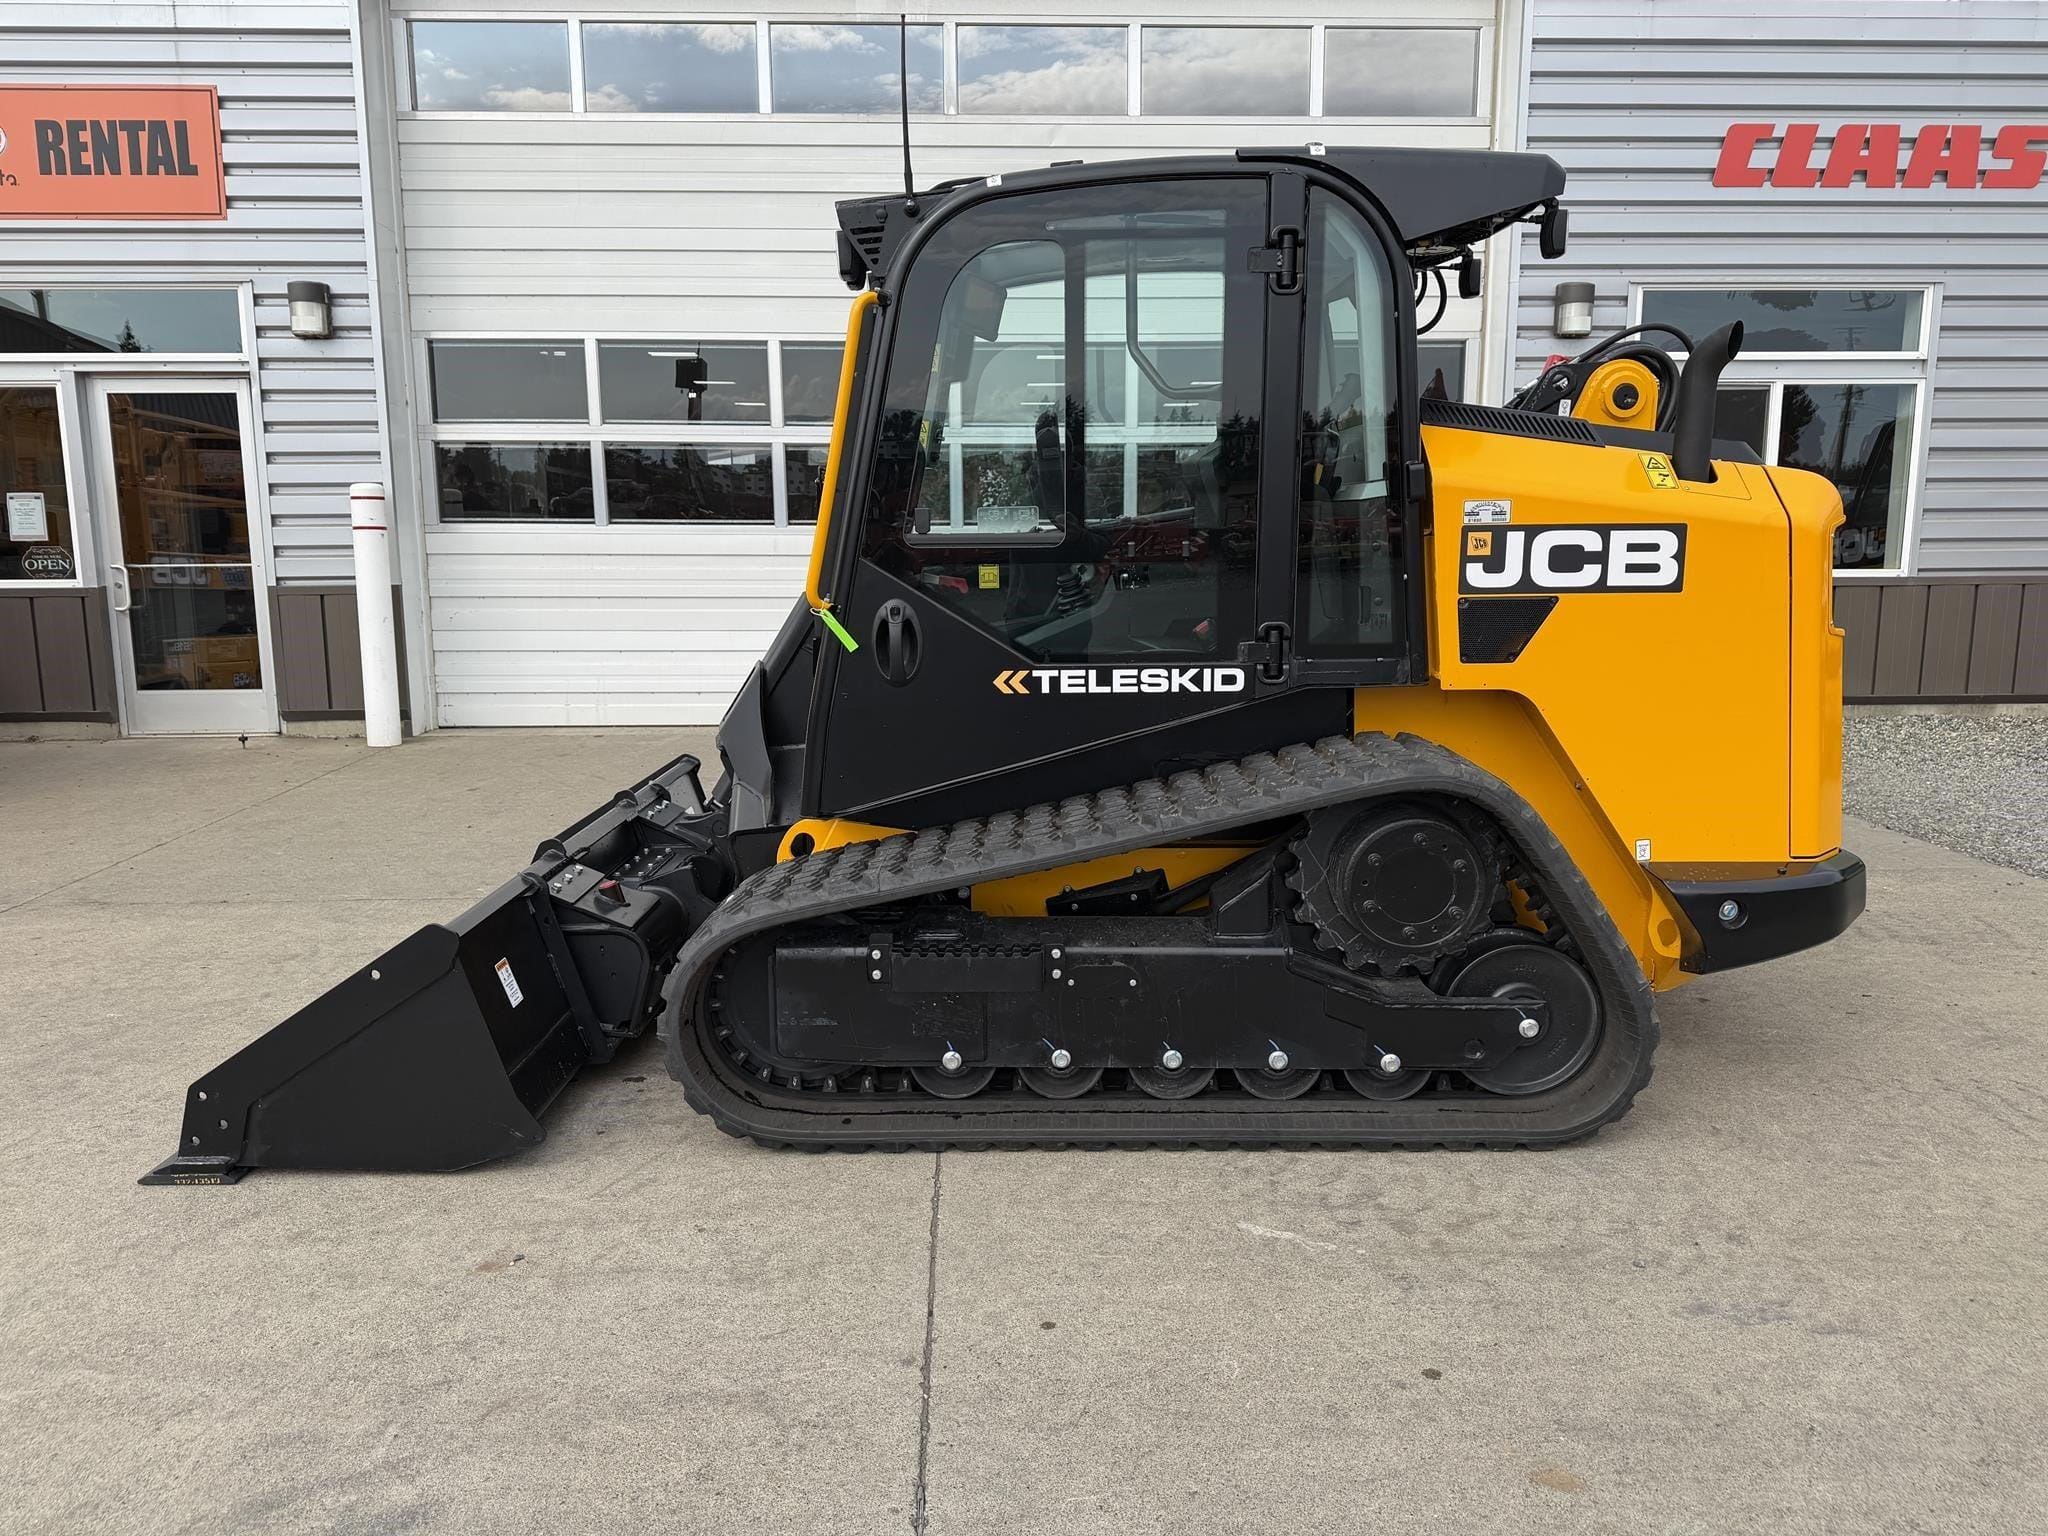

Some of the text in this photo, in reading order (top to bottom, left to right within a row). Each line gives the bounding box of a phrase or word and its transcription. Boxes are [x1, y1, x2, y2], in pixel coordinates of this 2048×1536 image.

[34, 119, 199, 176] RENTAL
[1712, 123, 2048, 189] CLAAS
[24, 559, 70, 570] OPEN
[1465, 529, 1680, 588] JCB
[1032, 667, 1245, 694] TELESKID
